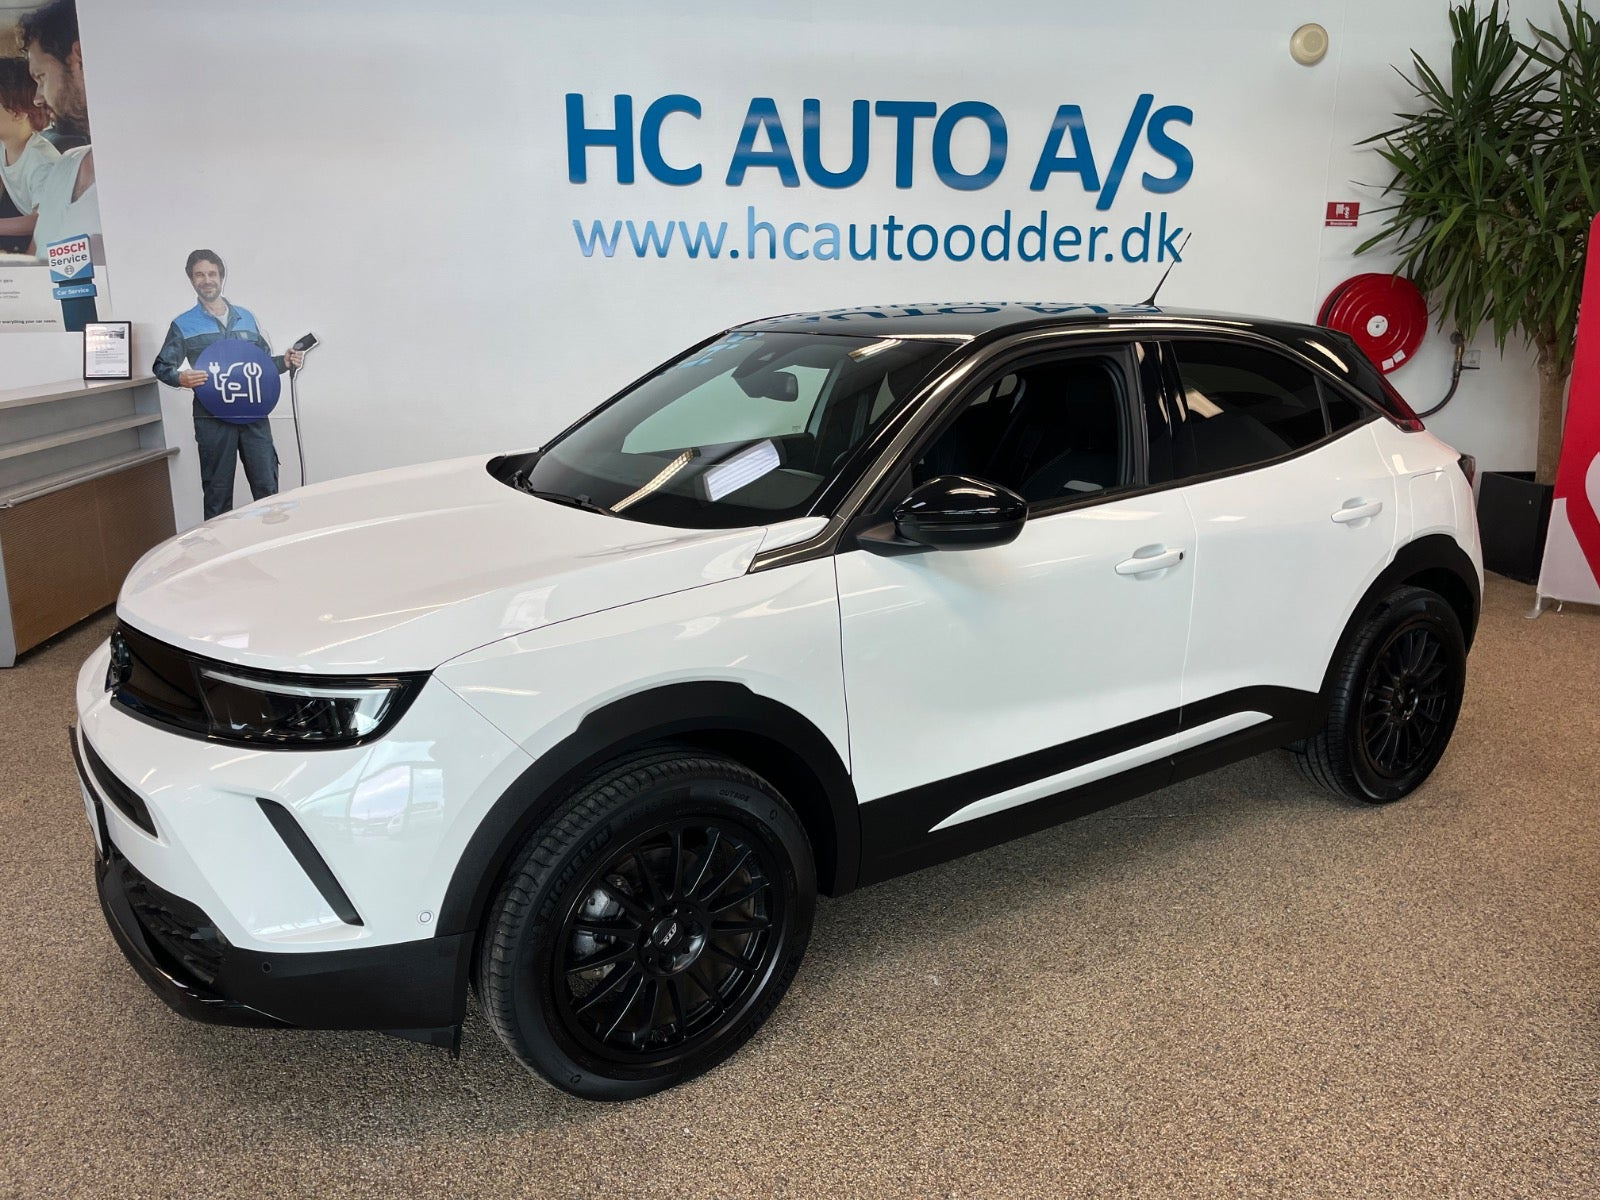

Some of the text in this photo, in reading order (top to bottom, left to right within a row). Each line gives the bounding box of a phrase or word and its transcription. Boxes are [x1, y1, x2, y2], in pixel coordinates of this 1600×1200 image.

[565, 92, 1194, 212] HC AUTO A/S
[572, 205, 1183, 263] www.hcautoodder.dk
[49, 241, 86, 258] BOSCH
[50, 253, 88, 267] Service
[68, 288, 90, 296] Service
